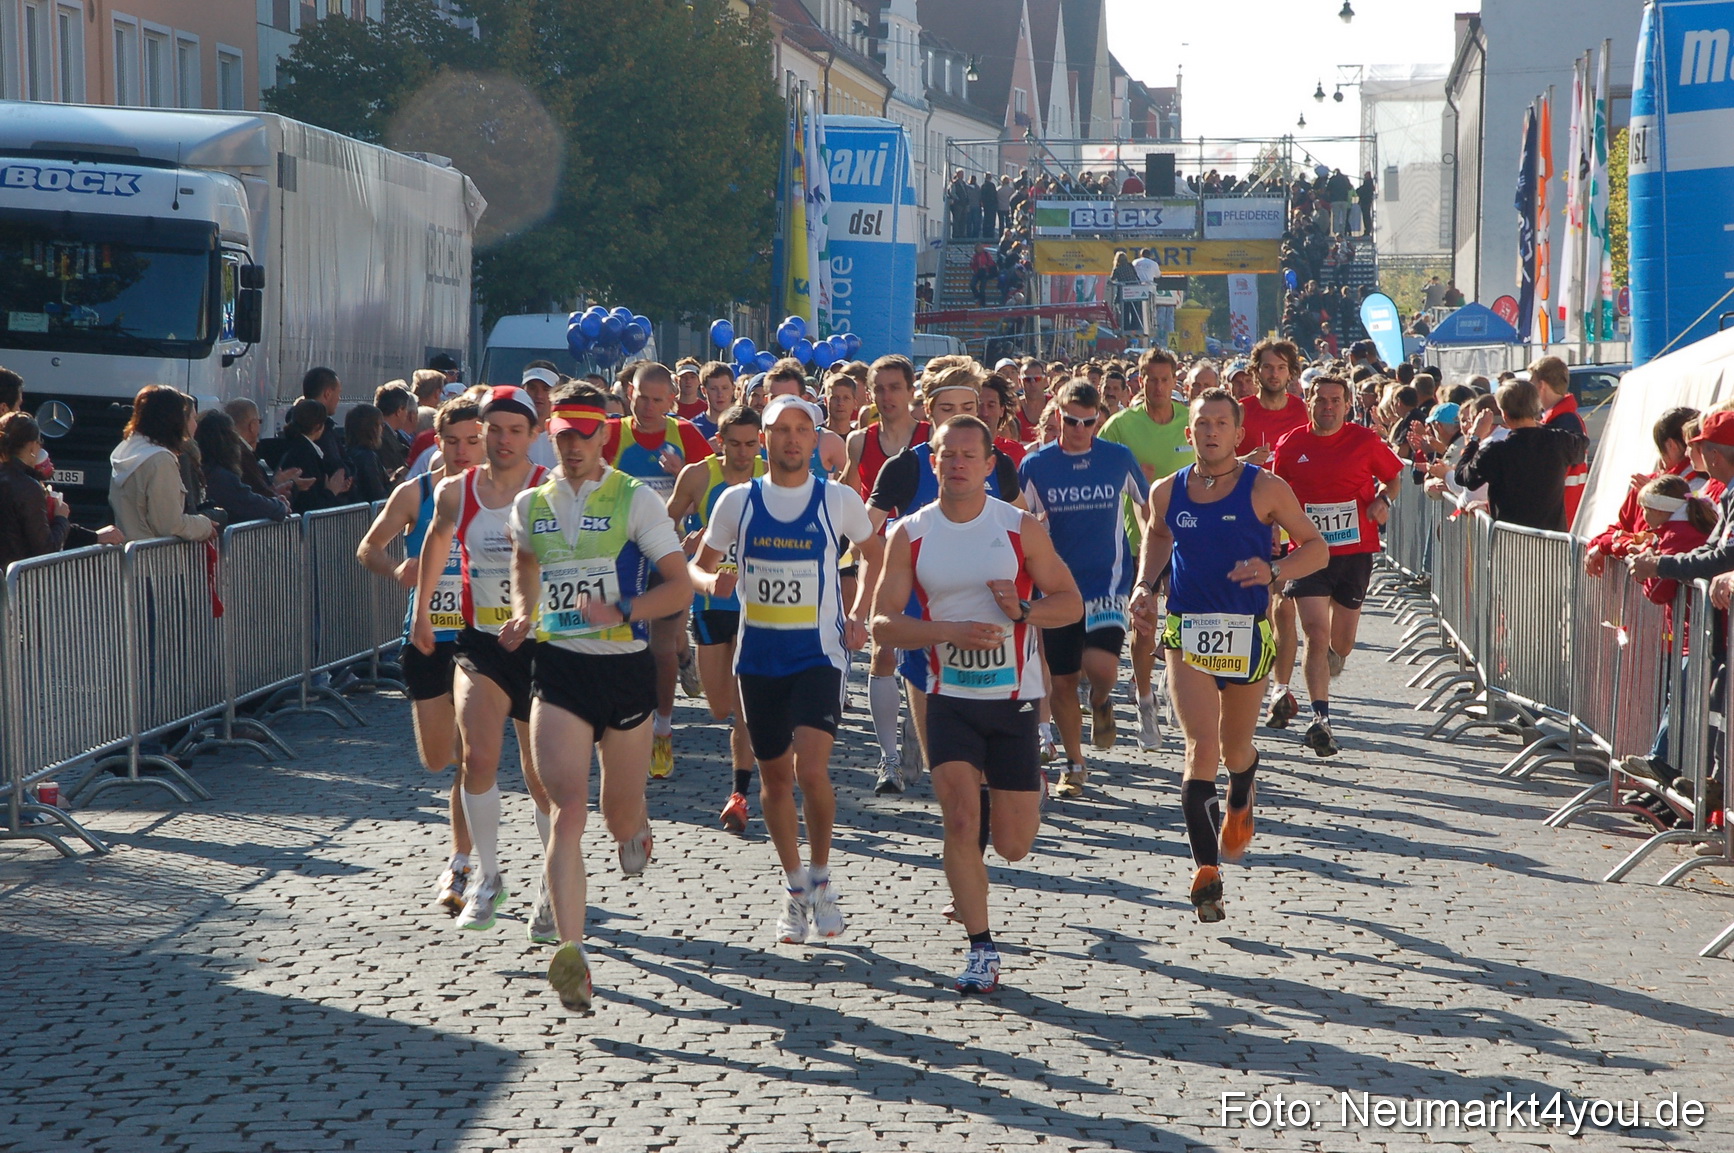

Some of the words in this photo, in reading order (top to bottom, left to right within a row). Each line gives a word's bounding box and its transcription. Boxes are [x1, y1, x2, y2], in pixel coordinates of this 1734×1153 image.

[1679, 28, 1734, 86] m
[827, 142, 889, 186] axi
[0, 165, 142, 197] BOCK
[848, 209, 883, 235] dsl
[1071, 208, 1163, 228] BOCK
[1223, 210, 1280, 221] PFLEIDERER
[58, 472, 79, 483] 185
[1047, 484, 1115, 504] SYSCAD
[1312, 513, 1353, 531] 3117
[753, 537, 771, 547] LAC
[773, 537, 812, 549] QUELLE
[1321, 529, 1352, 542] anfred
[758, 579, 802, 604] 923
[1197, 630, 1234, 654] 821
[945, 641, 1006, 669] 2000
[1190, 652, 1242, 672] Wolfgang
